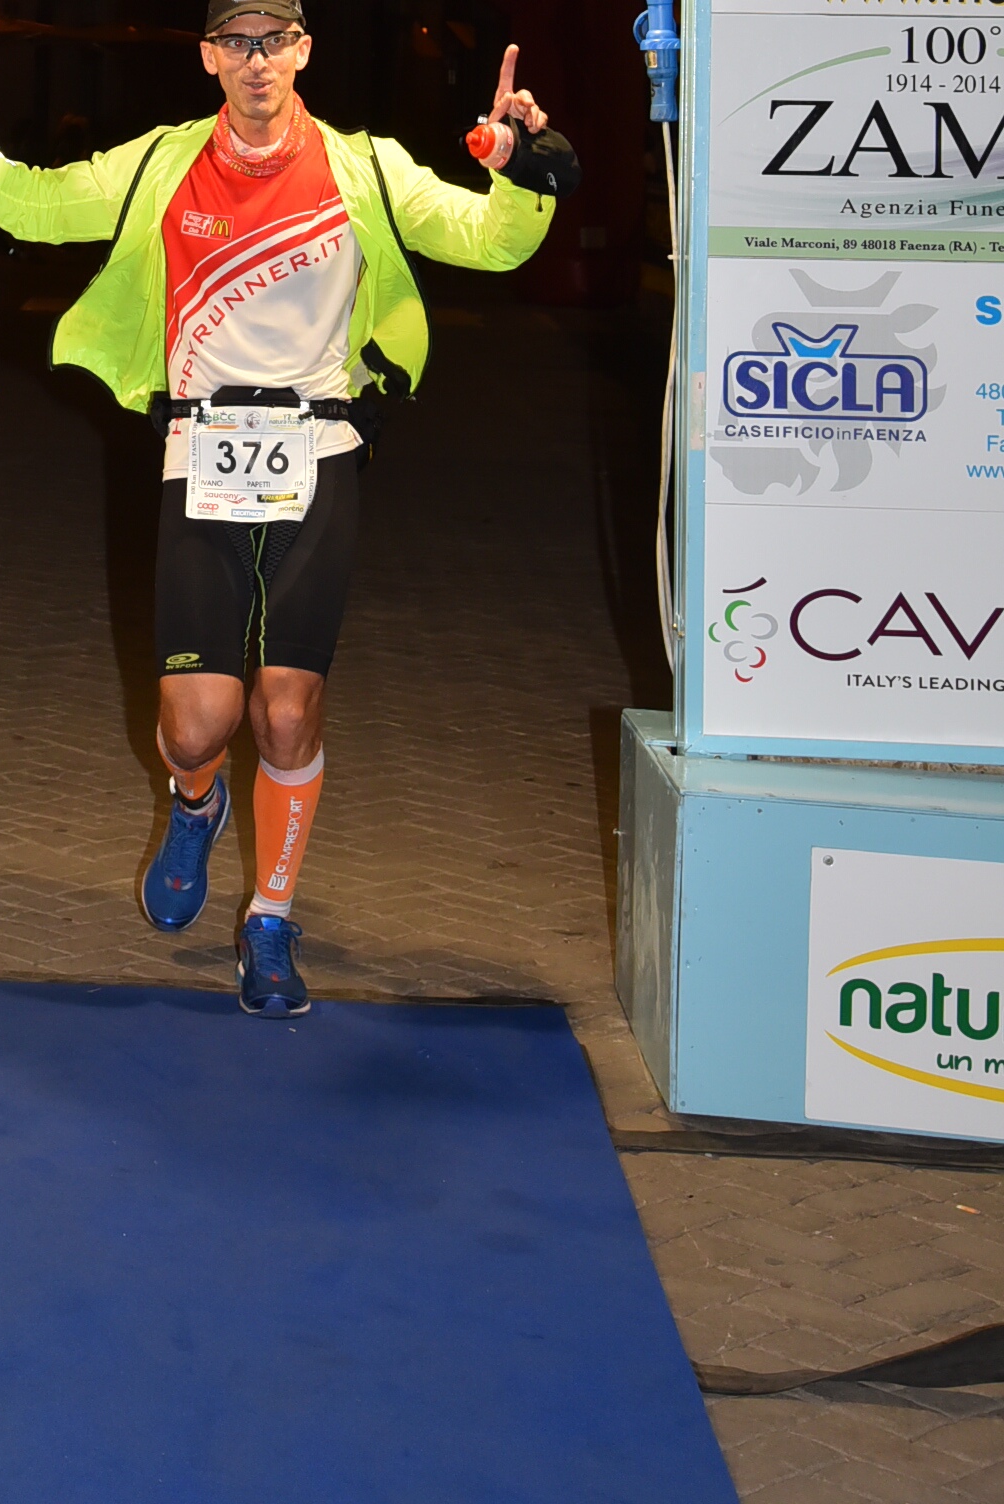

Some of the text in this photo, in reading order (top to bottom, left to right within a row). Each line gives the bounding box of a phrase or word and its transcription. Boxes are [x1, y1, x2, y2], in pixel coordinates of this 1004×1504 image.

[900, 25, 1002, 67] 100°
[885, 73, 1001, 94] 1914 2014
[839, 198, 938, 219] Agenzia
[744, 236, 978, 254] Viale Marconi, 89 48018 Faenza (RA)
[735, 360, 916, 414] SICLA
[724, 423, 927, 443] CASEIFICIOinFAENZA
[215, 439, 290, 476] 376
[200, 480, 271, 489] IVANO PAPETTI
[203, 491, 240, 501] saucony
[839, 972, 1001, 1041] natu
[936, 1052, 973, 1072] un
